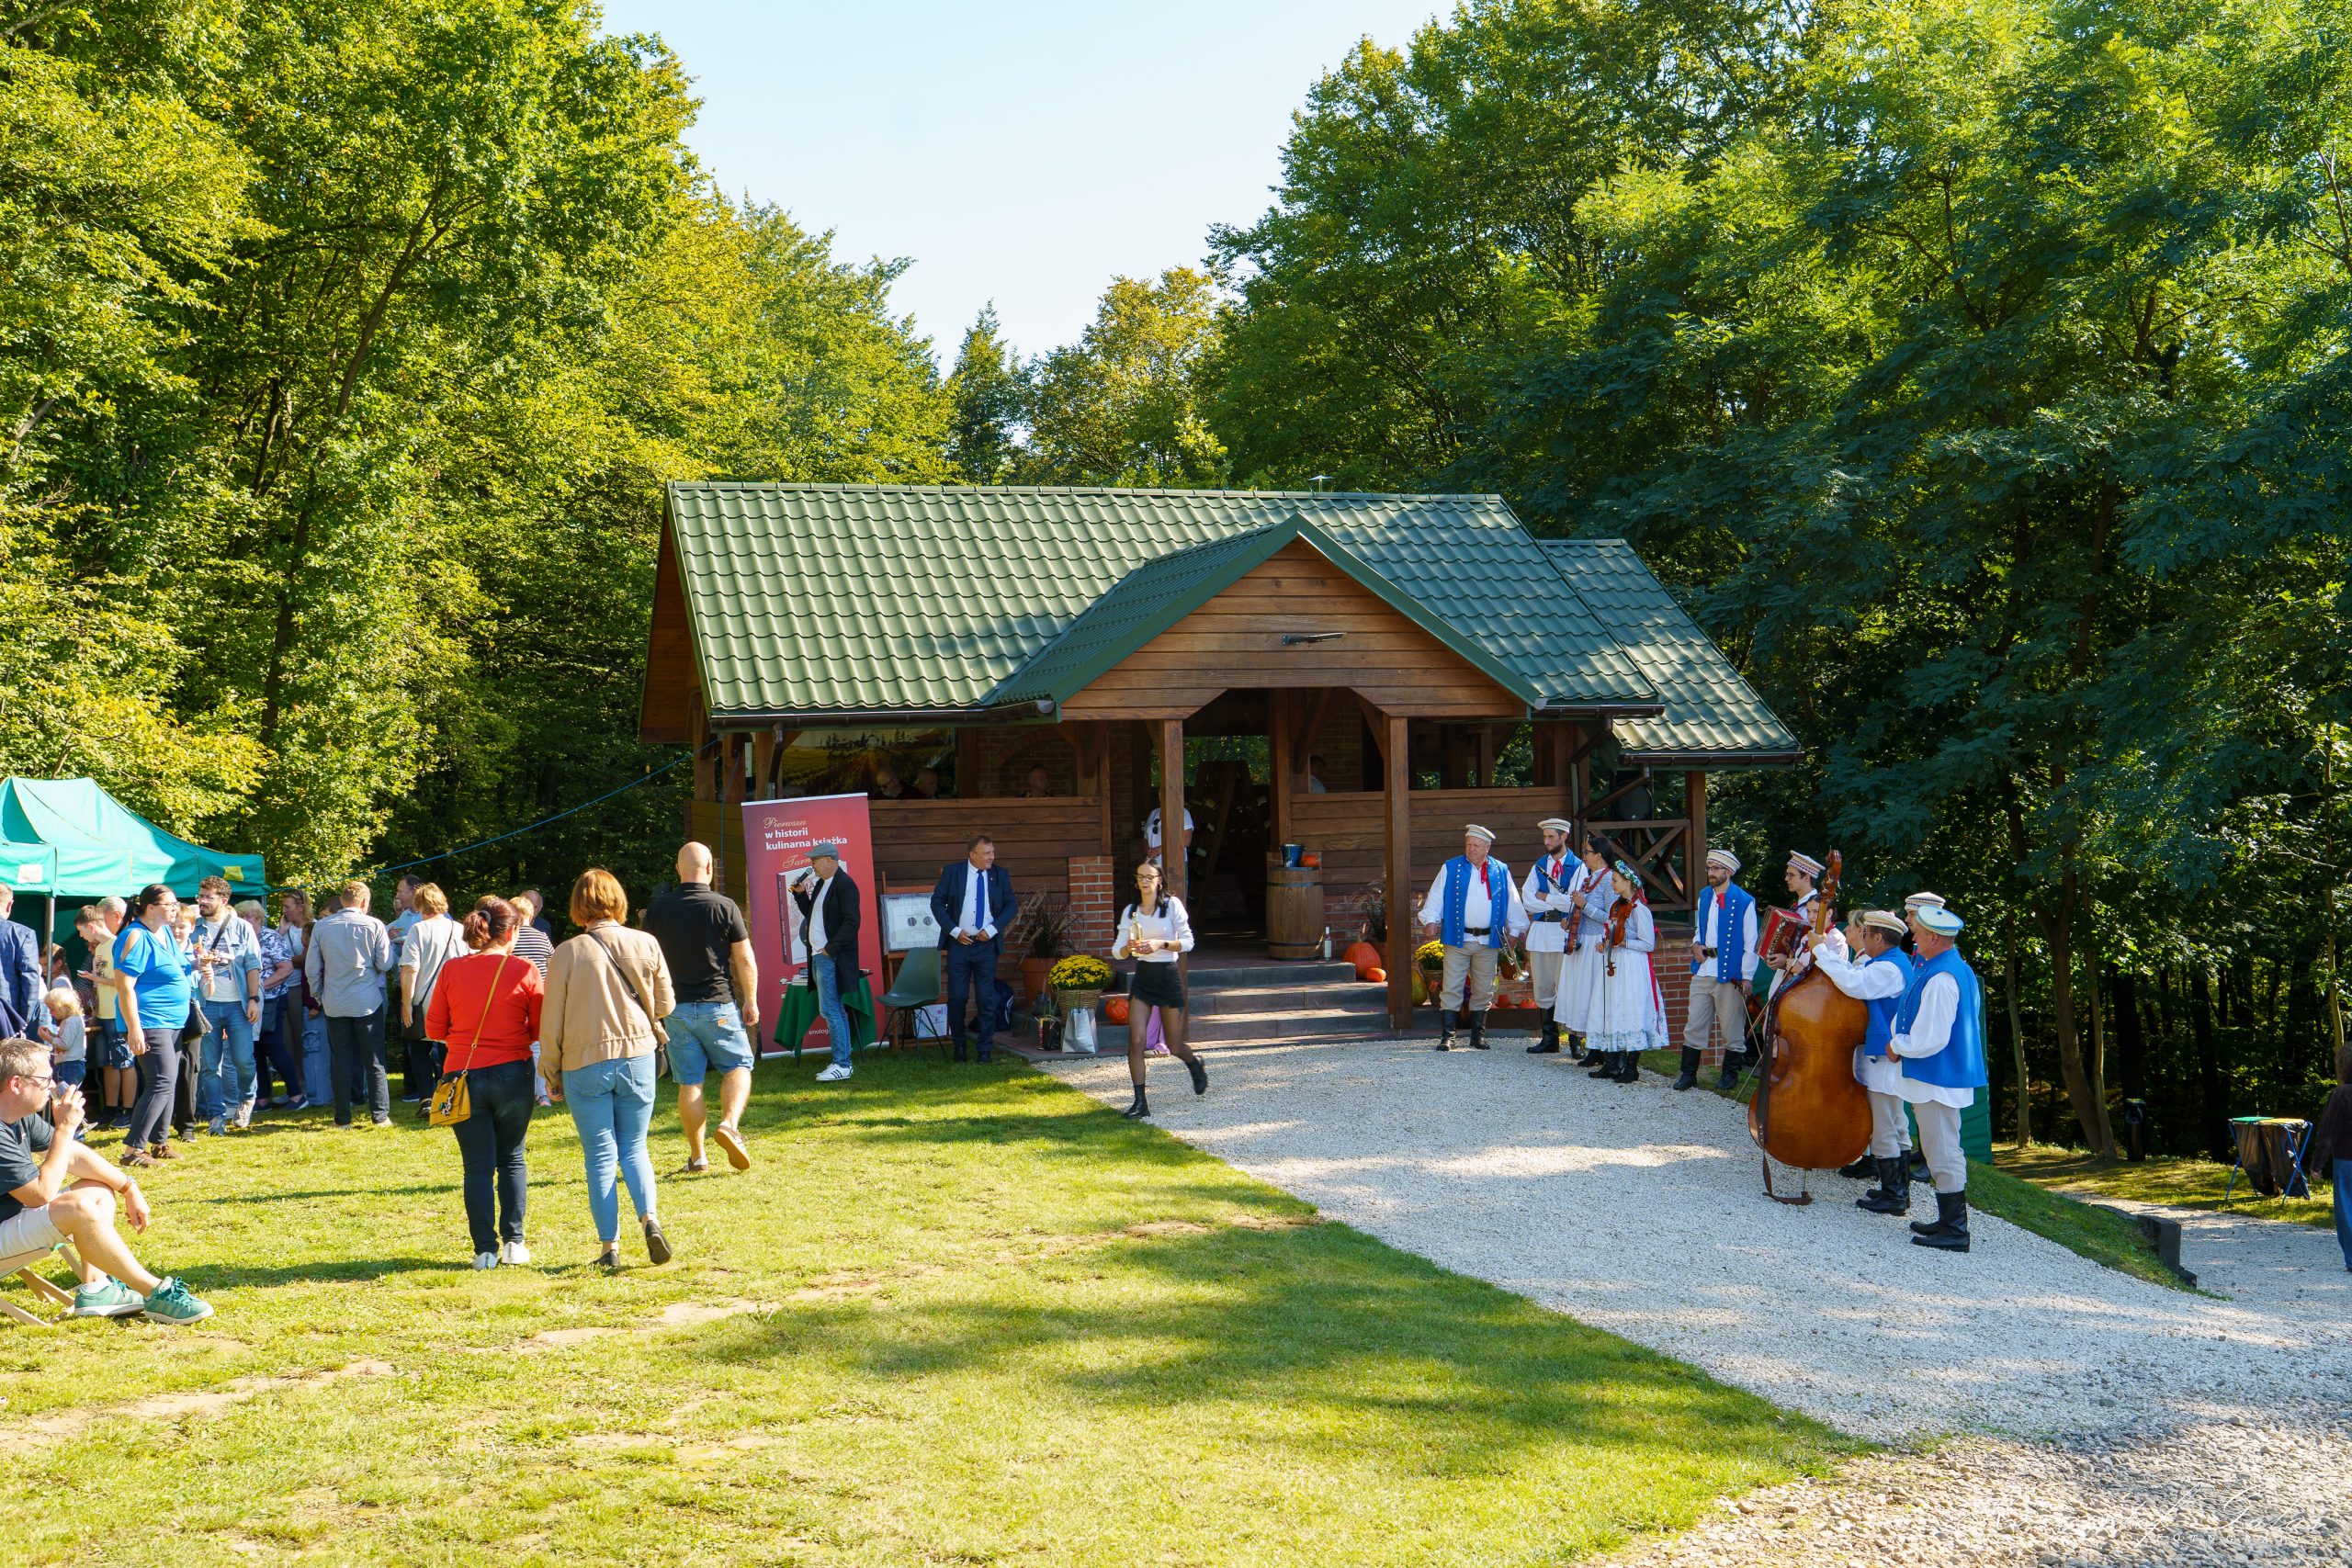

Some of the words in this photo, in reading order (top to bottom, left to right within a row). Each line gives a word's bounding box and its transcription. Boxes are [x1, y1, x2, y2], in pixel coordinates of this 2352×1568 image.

[763, 817, 806, 829] Pierwsza
[775, 828, 808, 838] historii
[765, 840, 810, 851] kulinarna
[783, 855, 811, 868] Tarn
